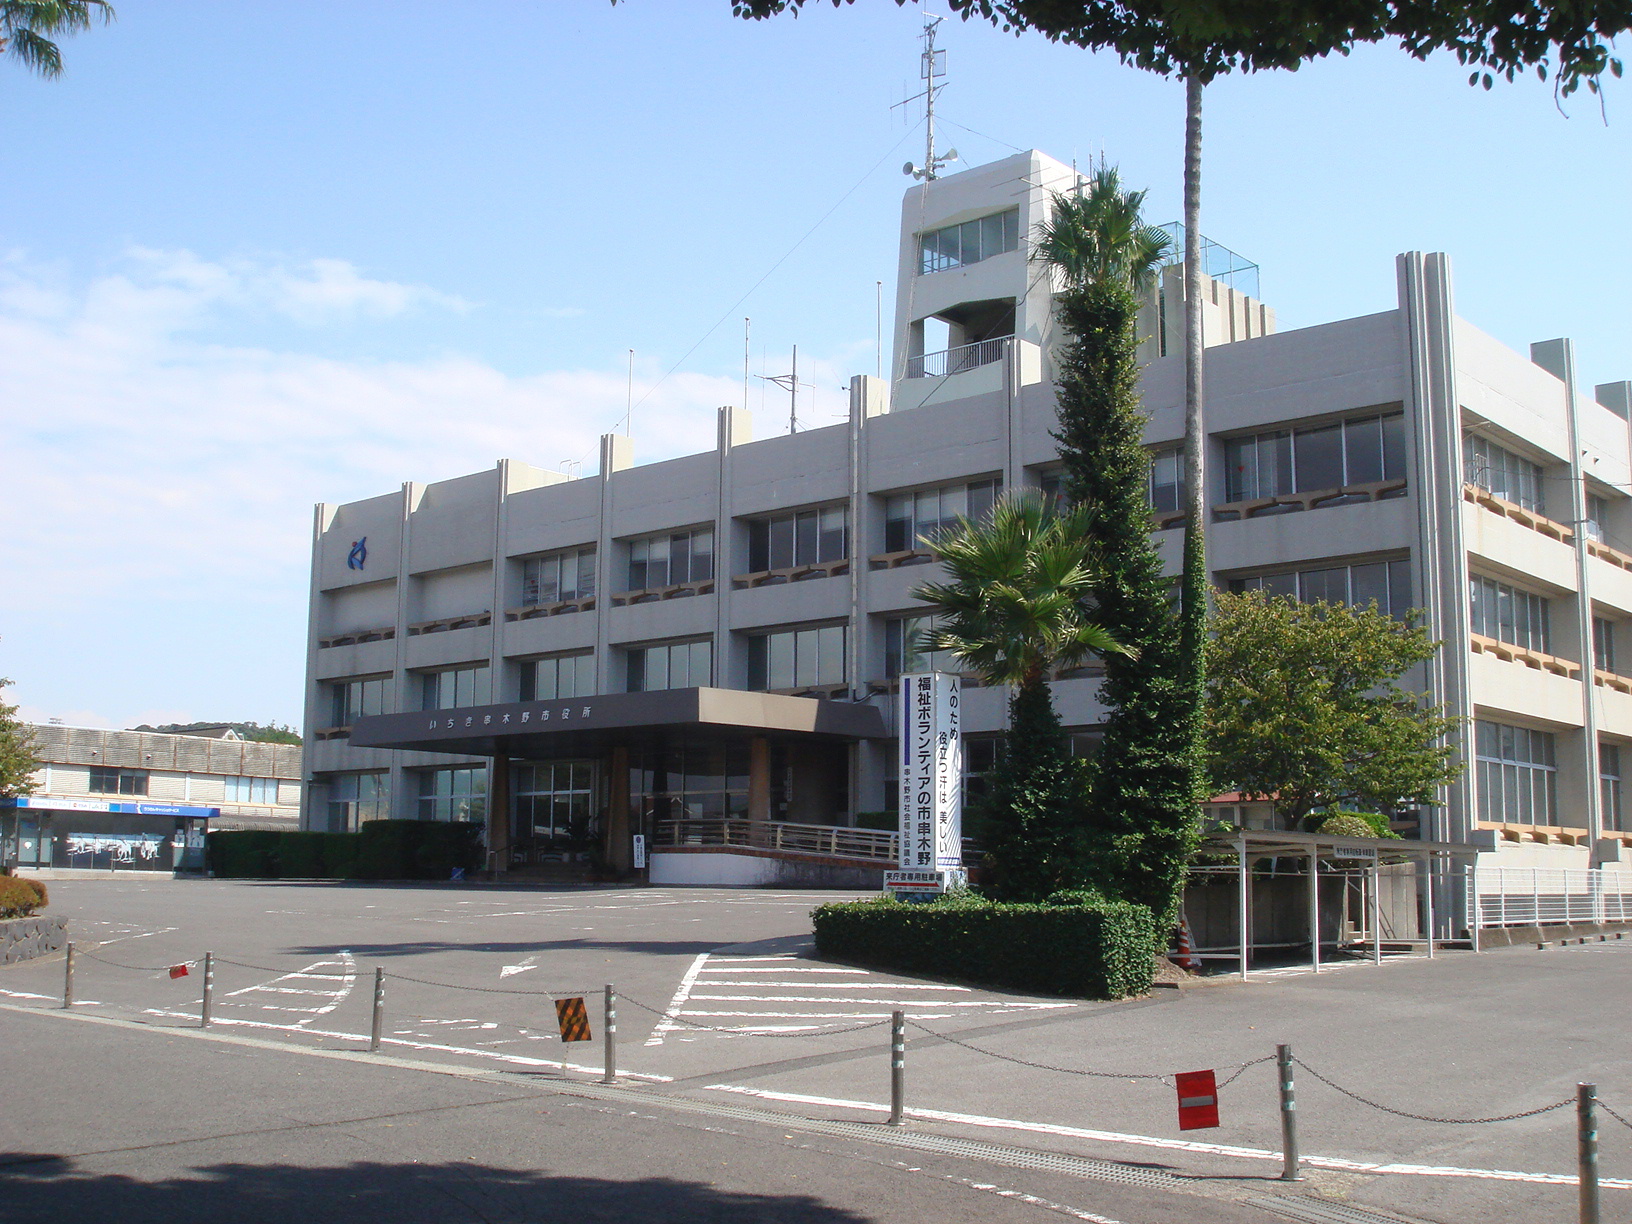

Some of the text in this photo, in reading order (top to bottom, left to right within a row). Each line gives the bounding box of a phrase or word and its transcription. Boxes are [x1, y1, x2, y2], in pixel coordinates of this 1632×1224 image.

[429, 706, 592, 730] いちき串木野市役所
[949, 679, 958, 740] 人のため
[917, 676, 931, 866] 福祉ボランティアの市串木野
